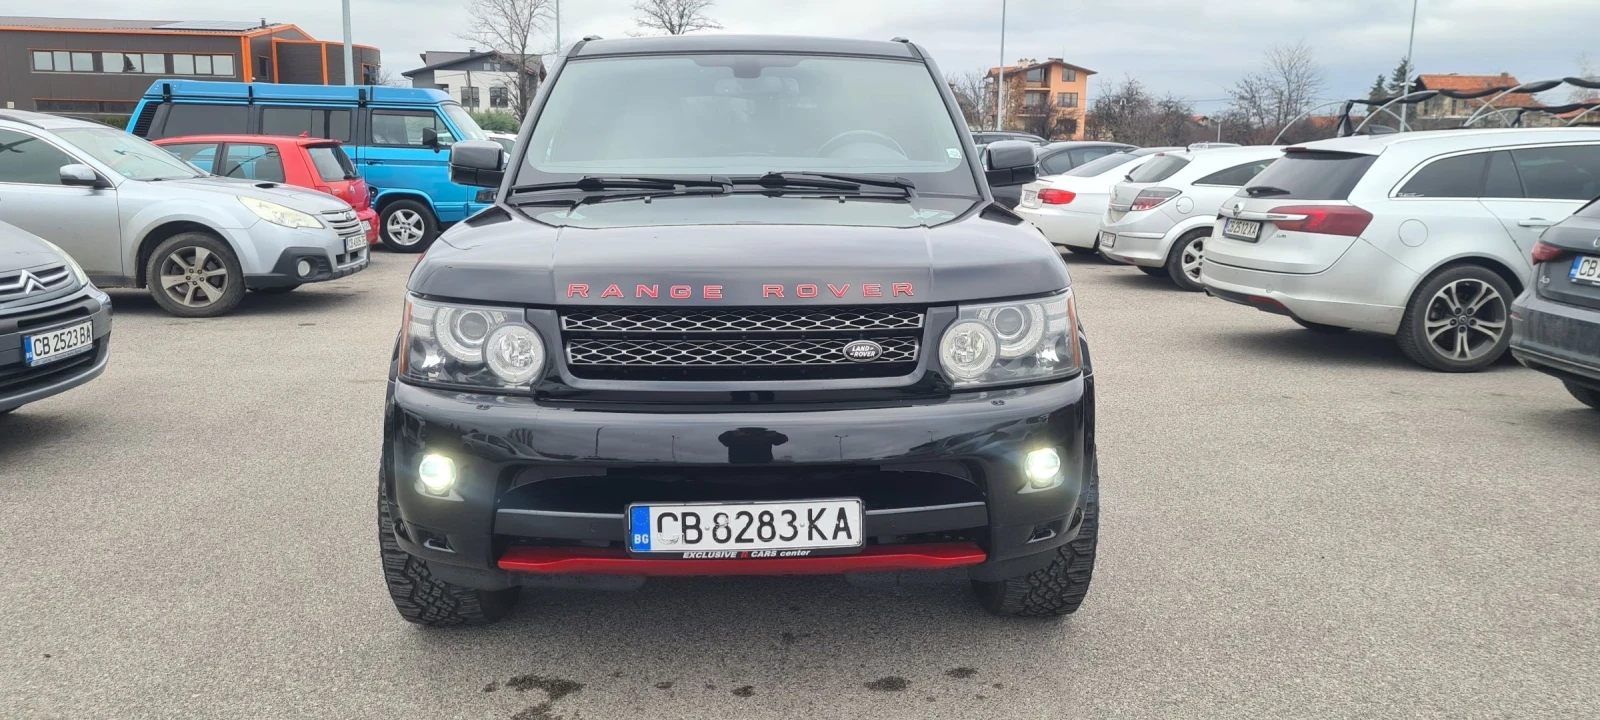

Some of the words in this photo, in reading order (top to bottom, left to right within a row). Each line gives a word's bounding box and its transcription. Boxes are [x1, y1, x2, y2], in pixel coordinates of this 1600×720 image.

[1234, 221, 1248, 235] 2512
[1246, 222, 1258, 237] XA
[1579, 259, 1598, 277] CB
[567, 283, 723, 299] RANGE
[762, 282, 915, 298] ROVER
[33, 336, 51, 357] CB
[53, 329, 79, 352] 2523
[80, 325, 92, 344] BA
[656, 511, 703, 545] CB
[712, 508, 799, 544] 8283
[807, 506, 853, 541] KA
[634, 533, 649, 544] BG
[682, 551, 738, 559] EXCLUSIVE
[751, 550, 777, 558] CARS
[780, 549, 811, 557] center
